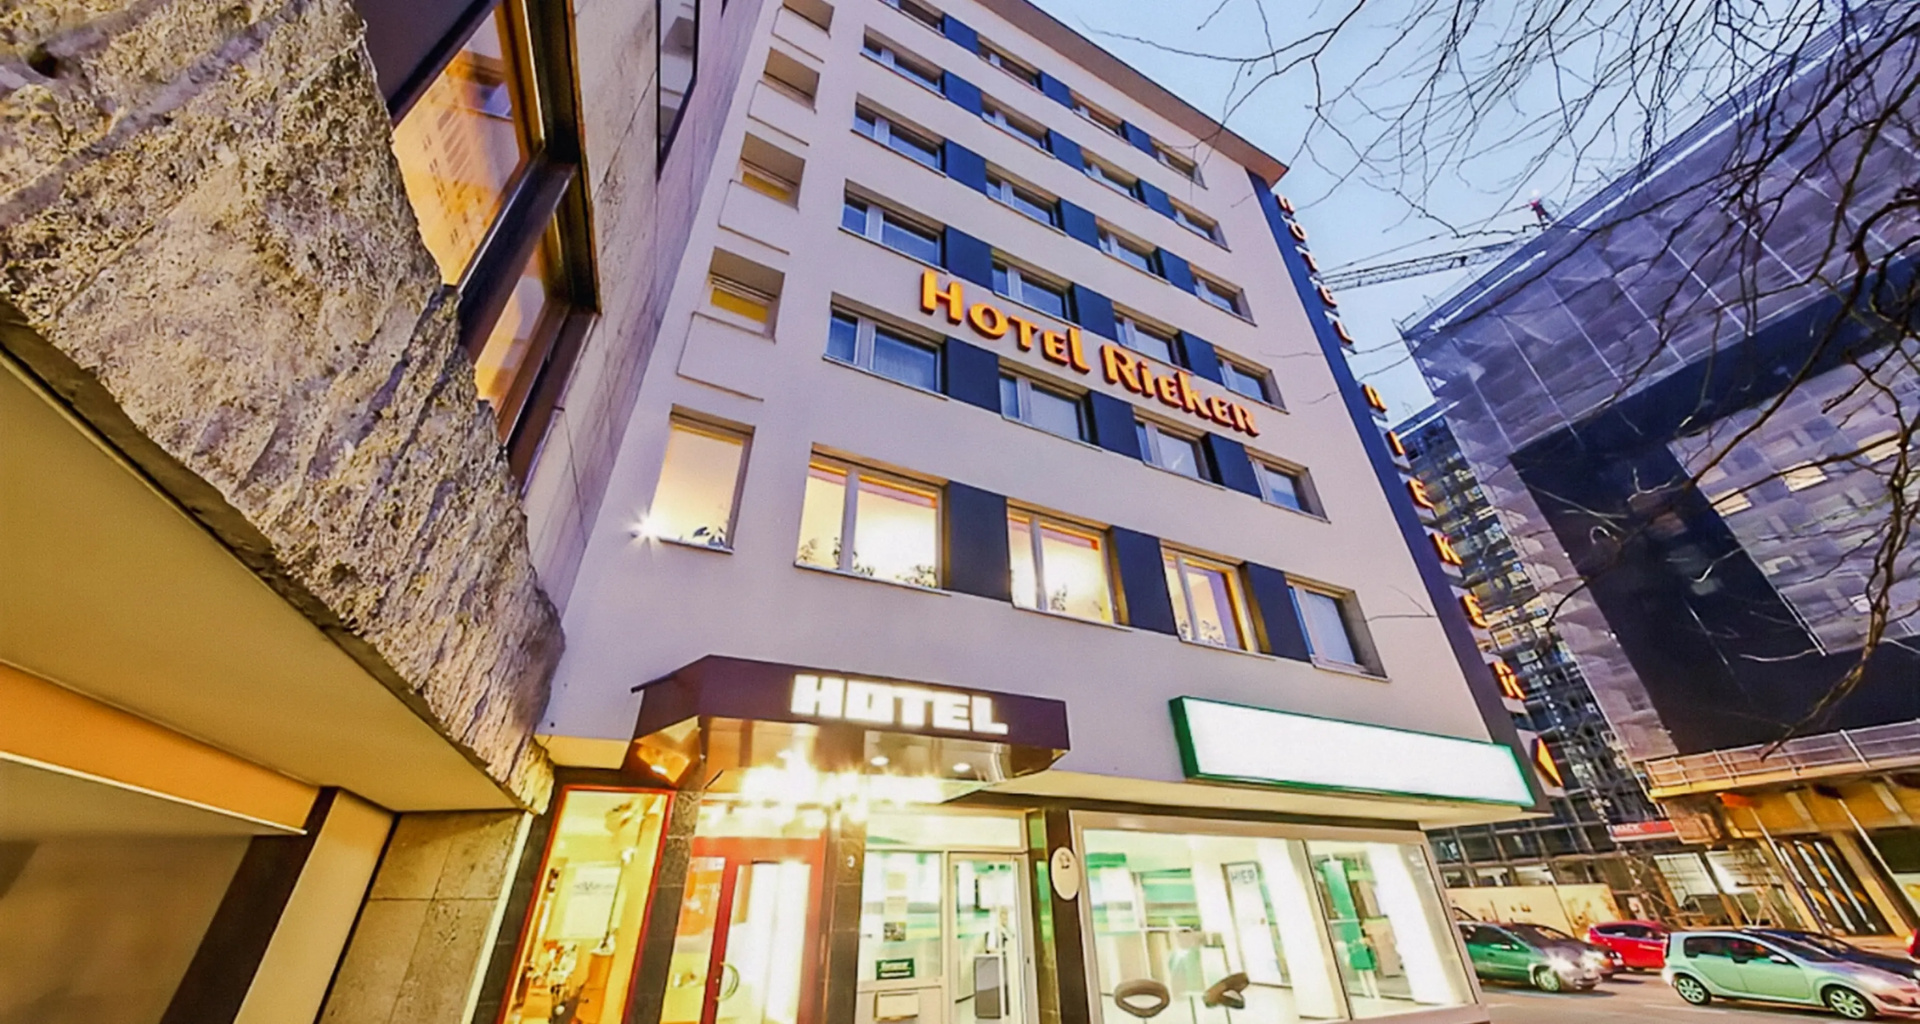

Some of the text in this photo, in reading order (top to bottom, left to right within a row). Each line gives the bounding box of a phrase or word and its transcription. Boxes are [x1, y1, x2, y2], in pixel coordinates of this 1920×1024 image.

[920, 267, 1091, 374] HOTEL
[1275, 193, 1527, 700] HOTEL RIEKER
[790, 673, 1009, 735] HOTEL
